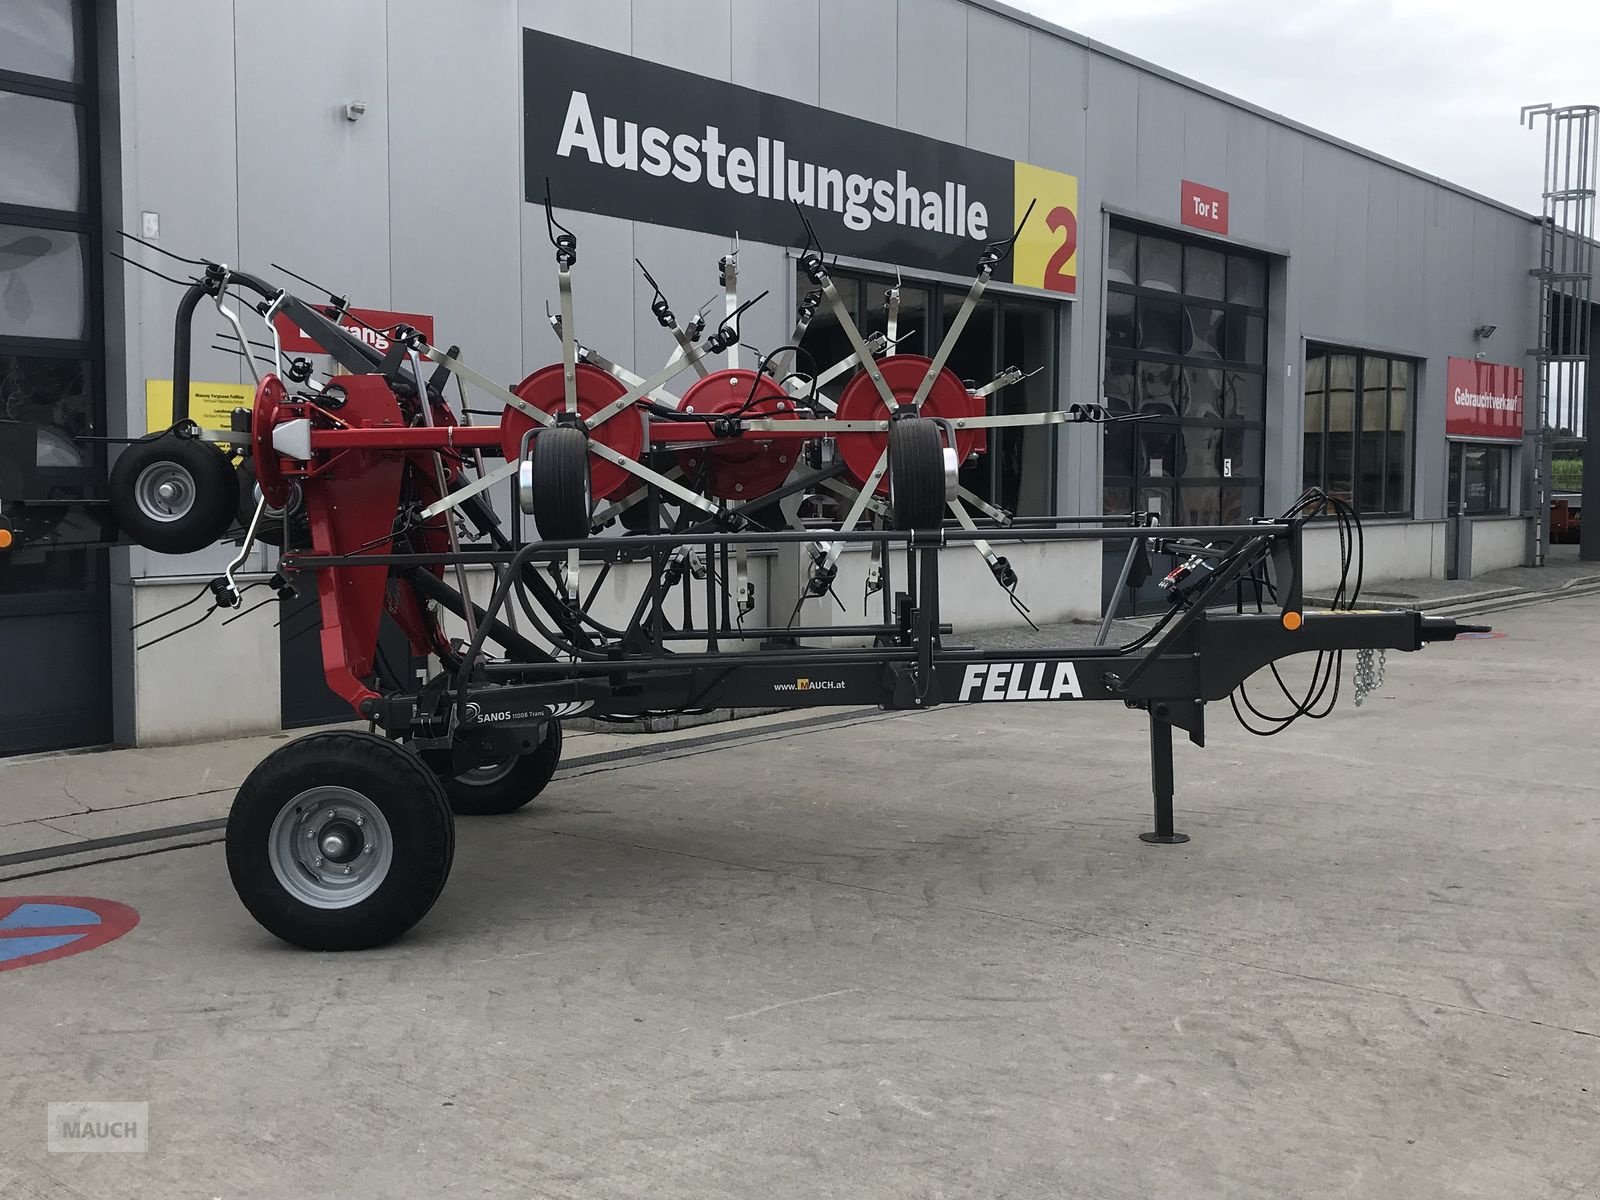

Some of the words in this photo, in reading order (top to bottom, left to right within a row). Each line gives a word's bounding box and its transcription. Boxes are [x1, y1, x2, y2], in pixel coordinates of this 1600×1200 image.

[556, 90, 989, 241] Ausstellungshalle
[1044, 206, 1077, 293] 2
[1193, 196, 1210, 217] Tor
[1212, 201, 1219, 220] E
[1454, 387, 1518, 411] Gebrauchtverkauf
[1225, 461, 1230, 476] 5
[773, 680, 846, 691] www.MAUCH.at
[958, 662, 1083, 701] FELLA
[477, 711, 512, 724] SANOS
